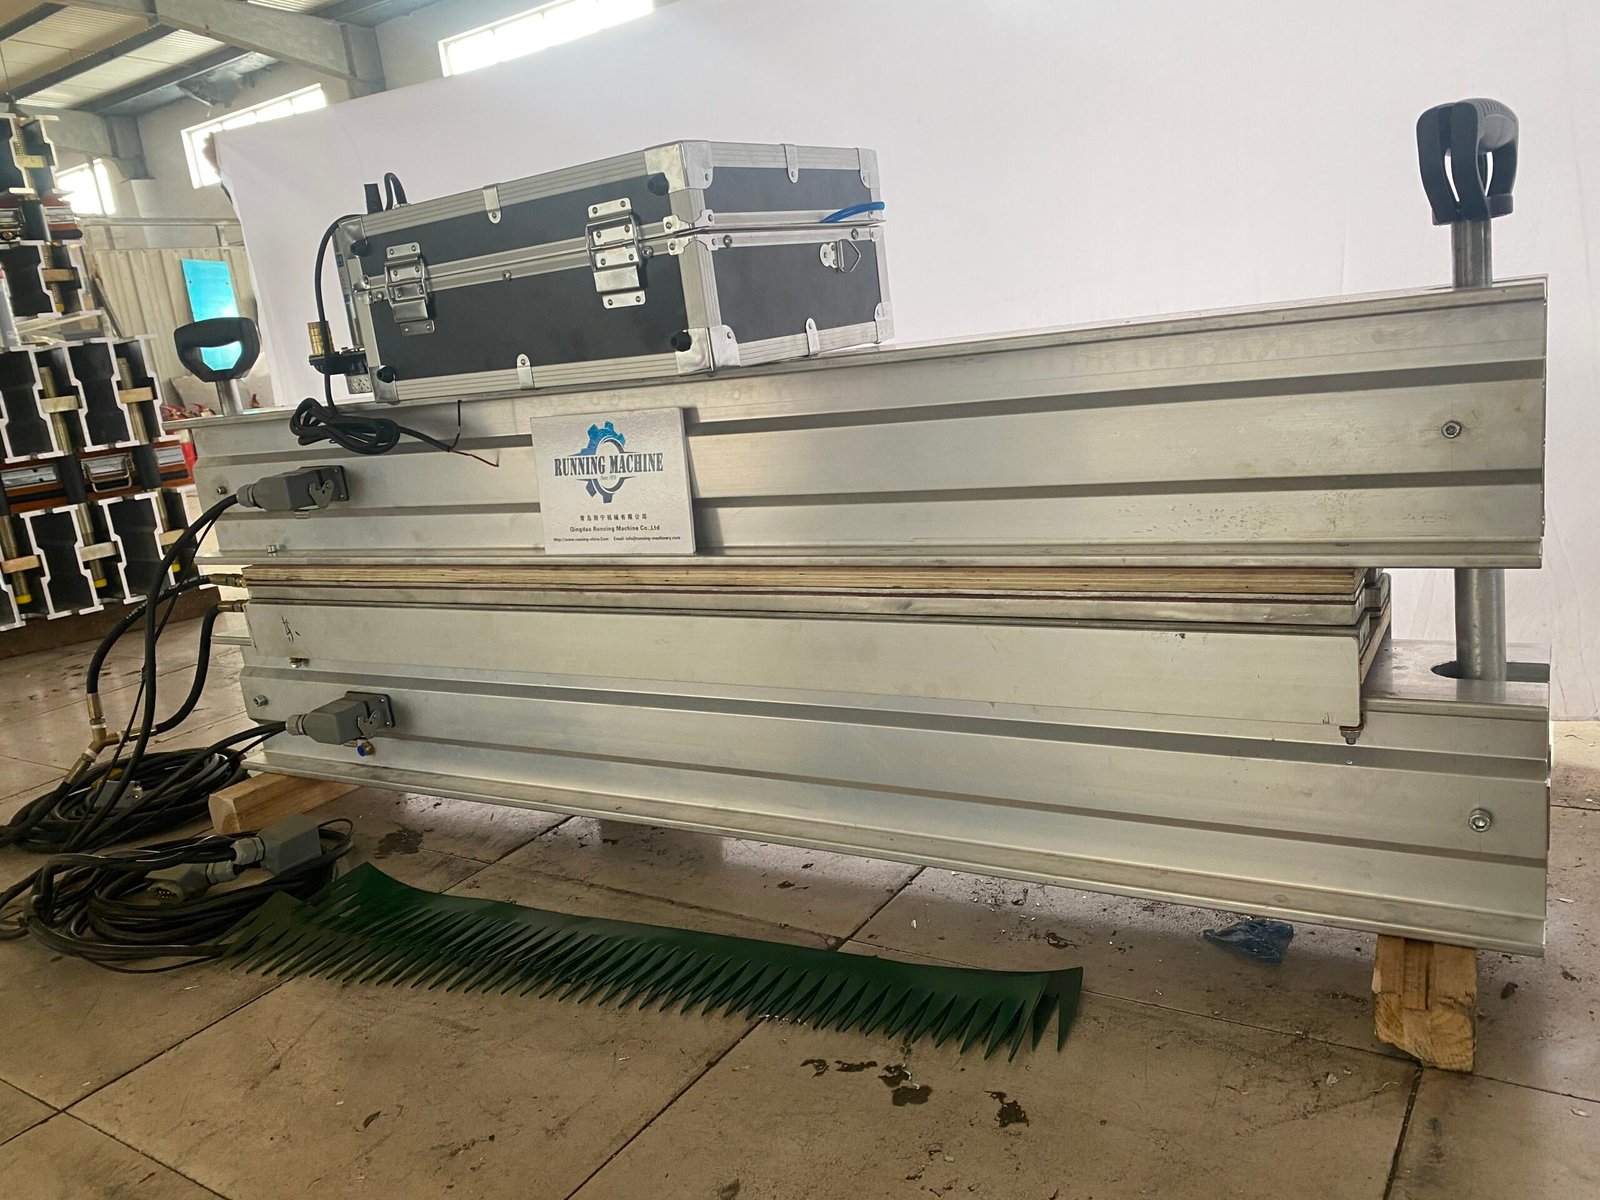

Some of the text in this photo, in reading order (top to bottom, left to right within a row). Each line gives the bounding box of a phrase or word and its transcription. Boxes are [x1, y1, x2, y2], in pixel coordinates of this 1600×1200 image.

[554, 452, 664, 477] RUNNING MACHINE
[593, 525, 615, 533] Running
